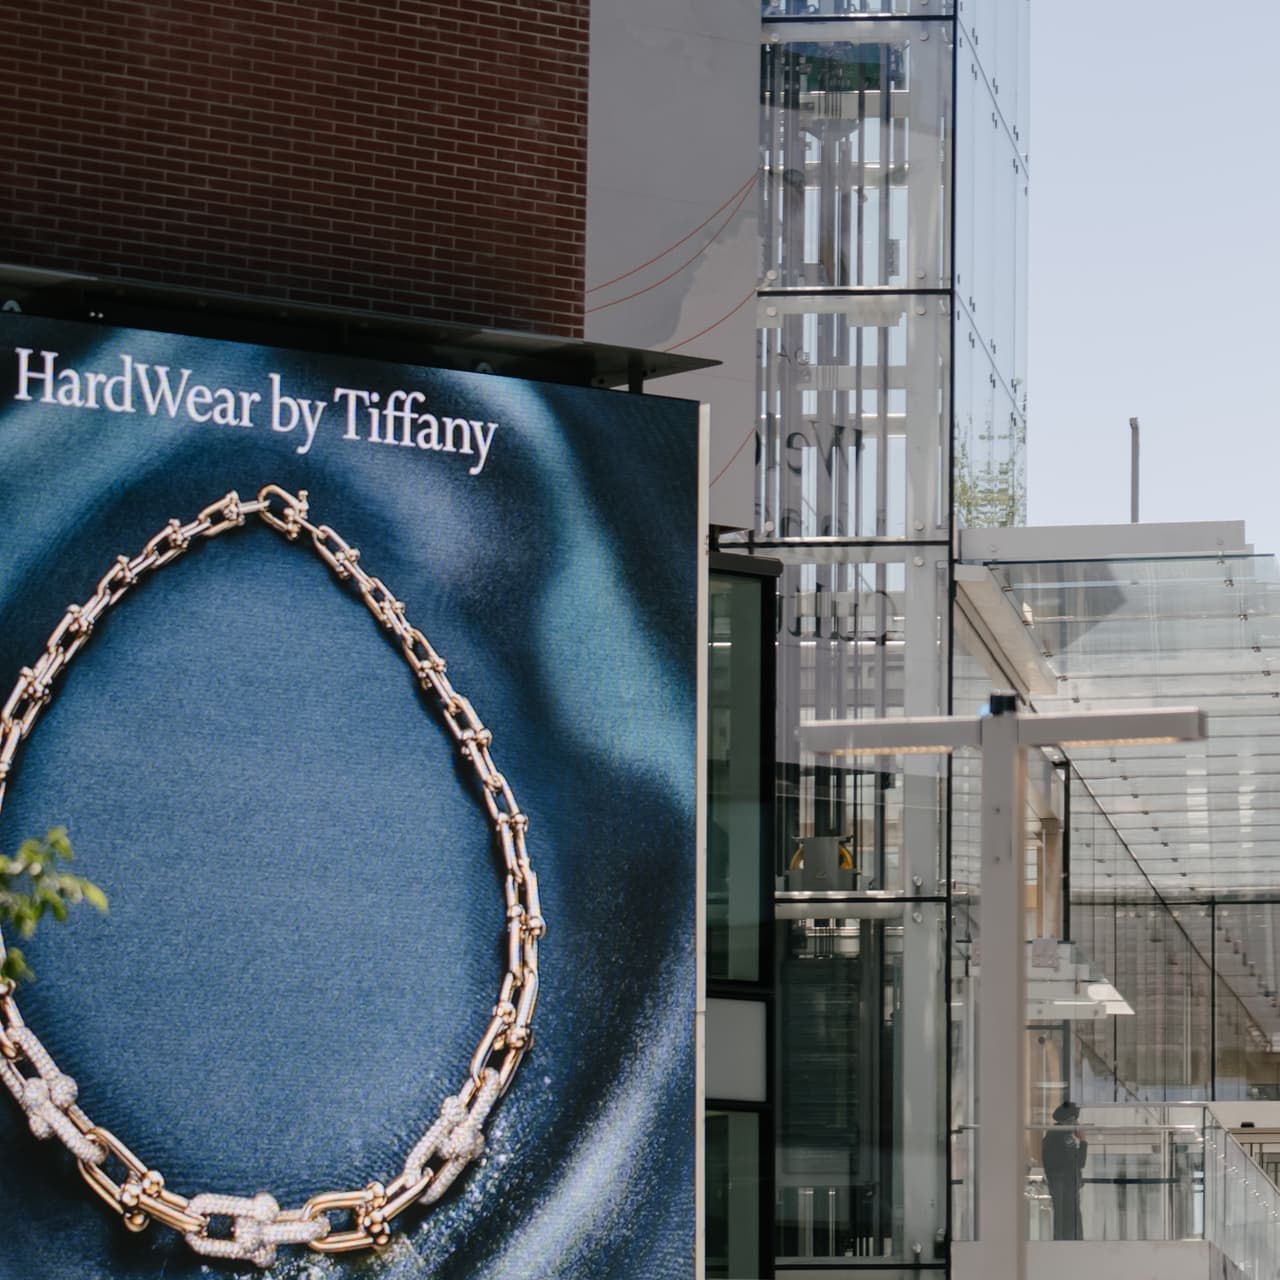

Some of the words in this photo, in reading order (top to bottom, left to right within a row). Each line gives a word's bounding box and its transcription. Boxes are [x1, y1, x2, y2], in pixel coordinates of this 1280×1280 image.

[14, 347, 259, 427] HardWear
[271, 373, 326, 453] by
[334, 387, 498, 474] Tiffany
